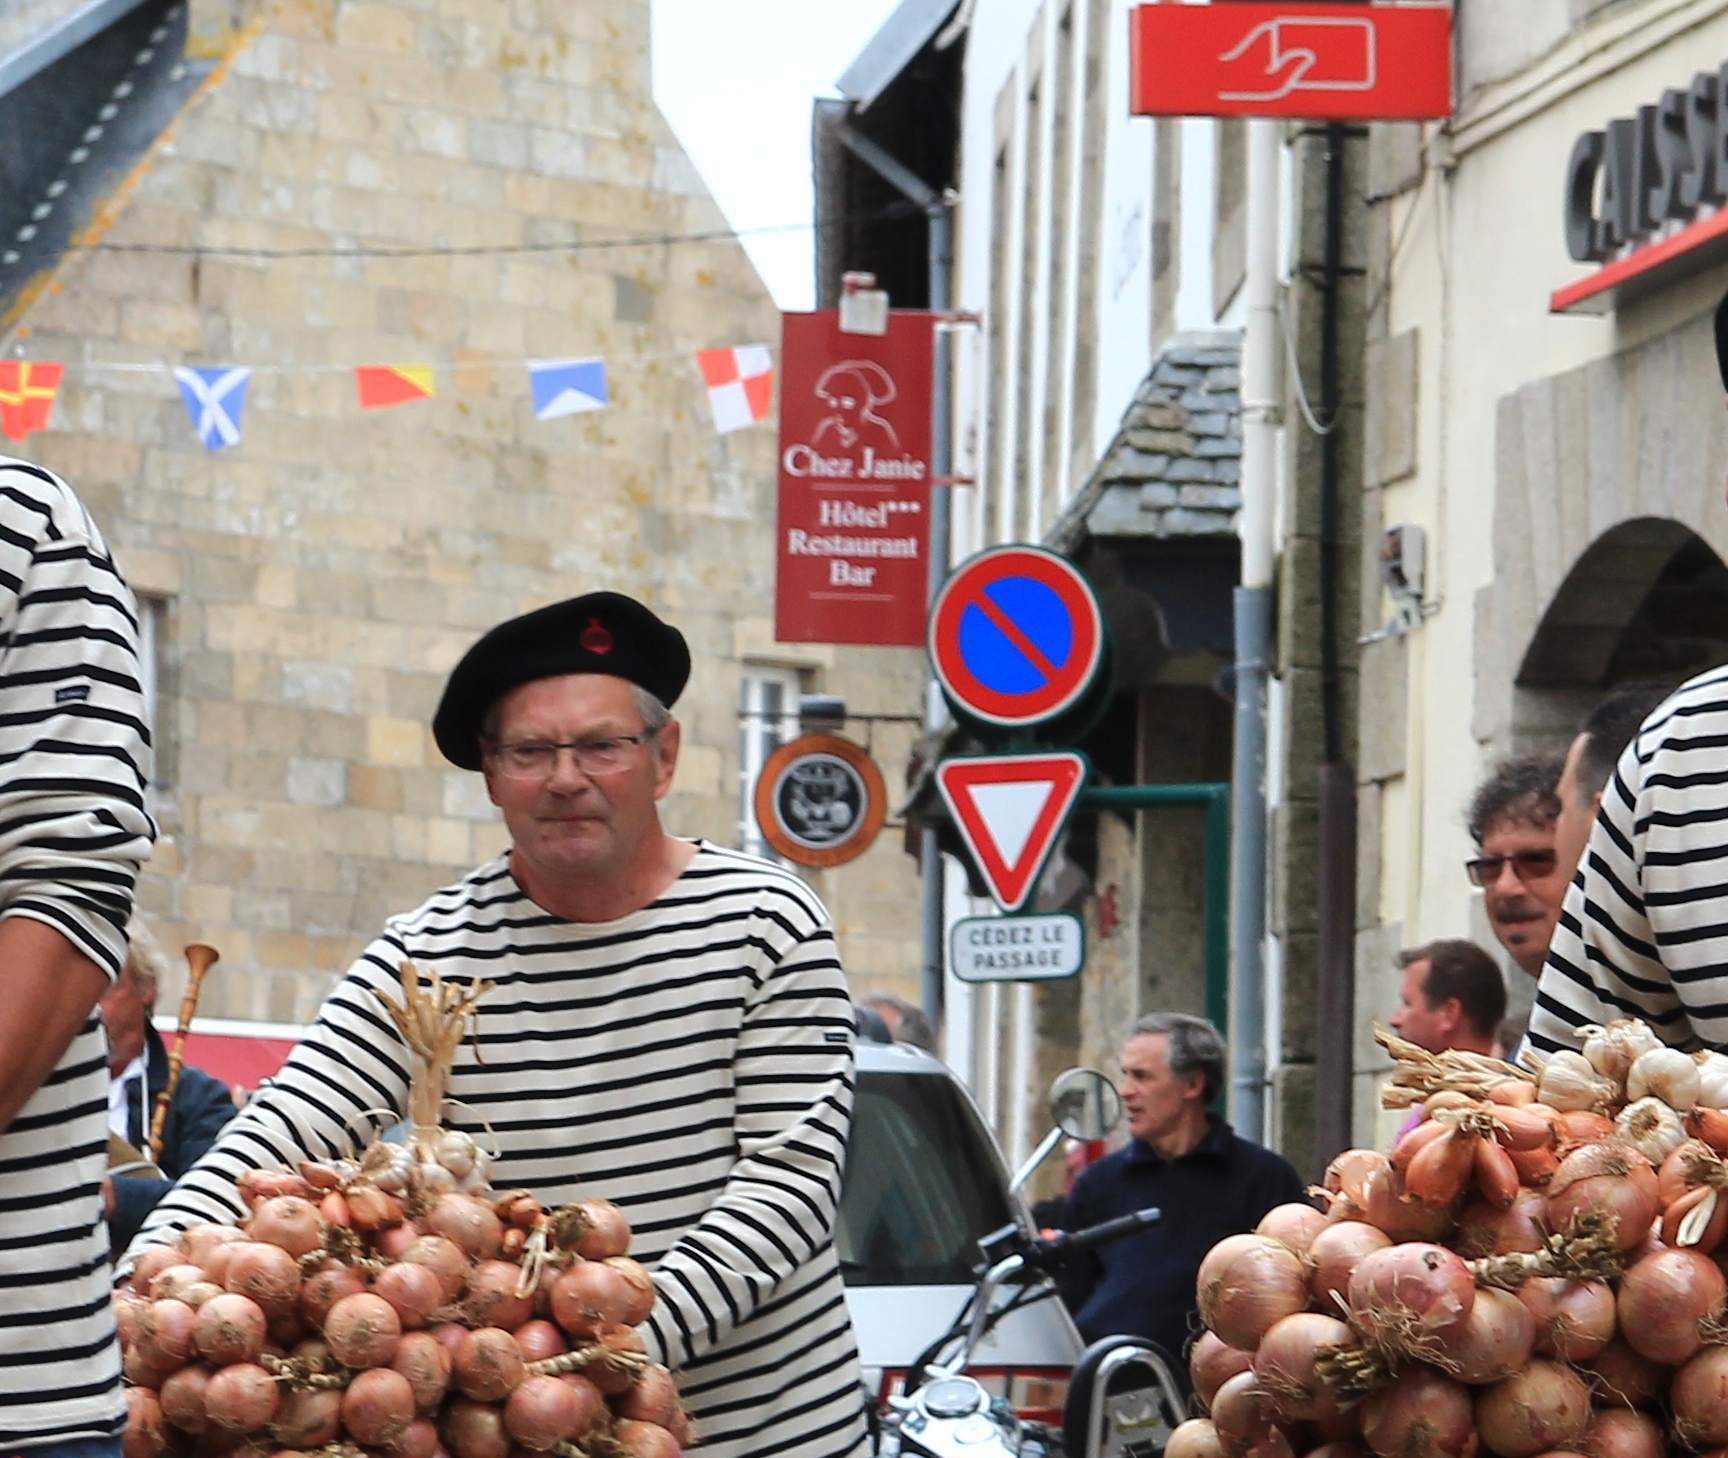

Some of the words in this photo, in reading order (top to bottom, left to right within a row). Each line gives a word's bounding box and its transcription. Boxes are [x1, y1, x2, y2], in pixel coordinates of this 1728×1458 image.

[783, 443, 853, 477] Chez
[857, 445, 925, 480] Janie
[788, 528, 918, 558] Restaurant
[830, 559, 876, 587] Bar
[970, 925, 1032, 945] CÉDEZ
[1042, 925, 1065, 942] LE
[974, 948, 1061, 967] PASSAGE
